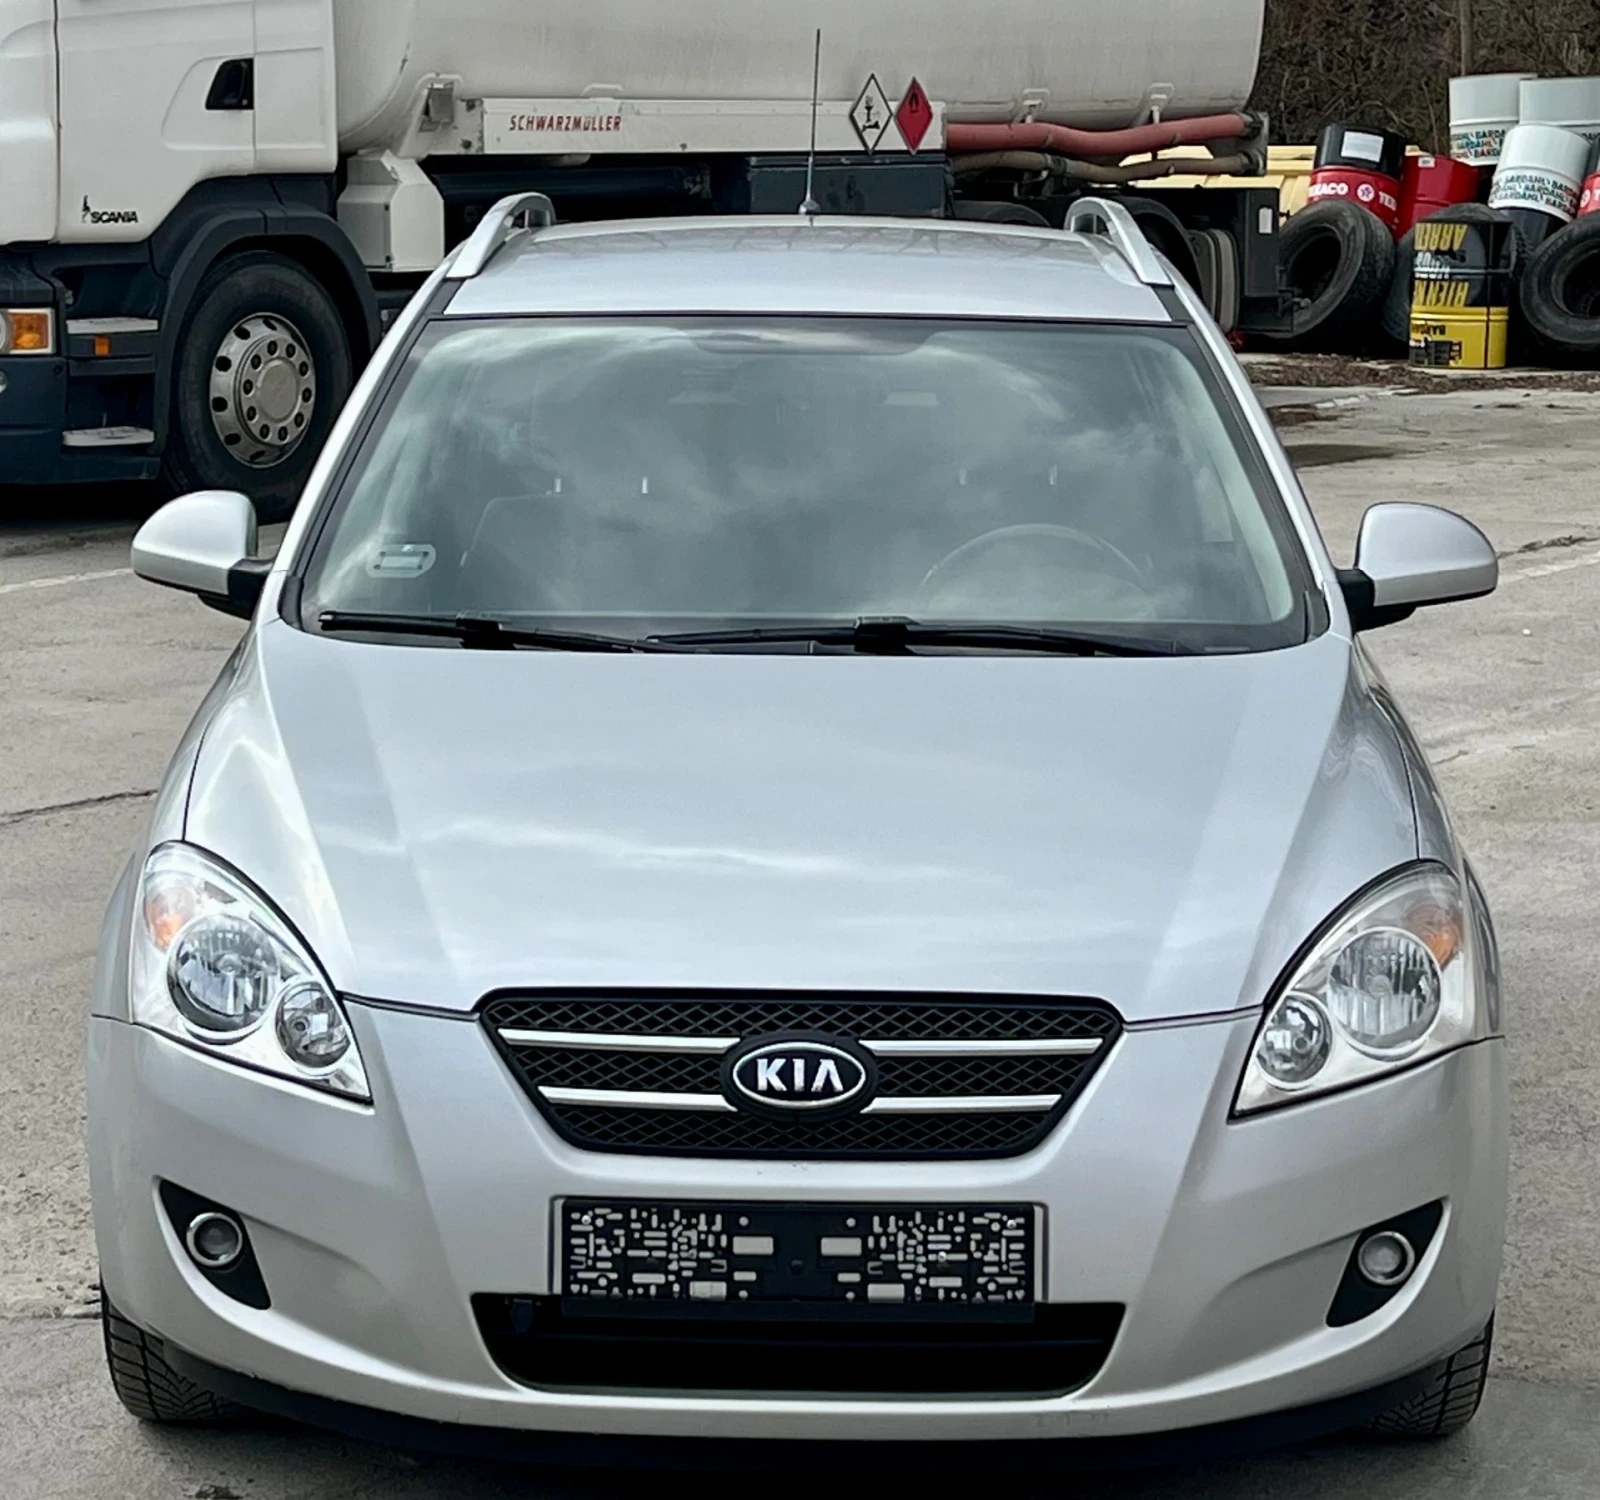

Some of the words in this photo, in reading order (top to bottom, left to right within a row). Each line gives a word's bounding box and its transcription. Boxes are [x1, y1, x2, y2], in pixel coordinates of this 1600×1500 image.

[509, 114, 622, 131] SCHWARZMÜLLER
[90, 210, 139, 224] SCANIA
[756, 1058, 844, 1093] KIA
